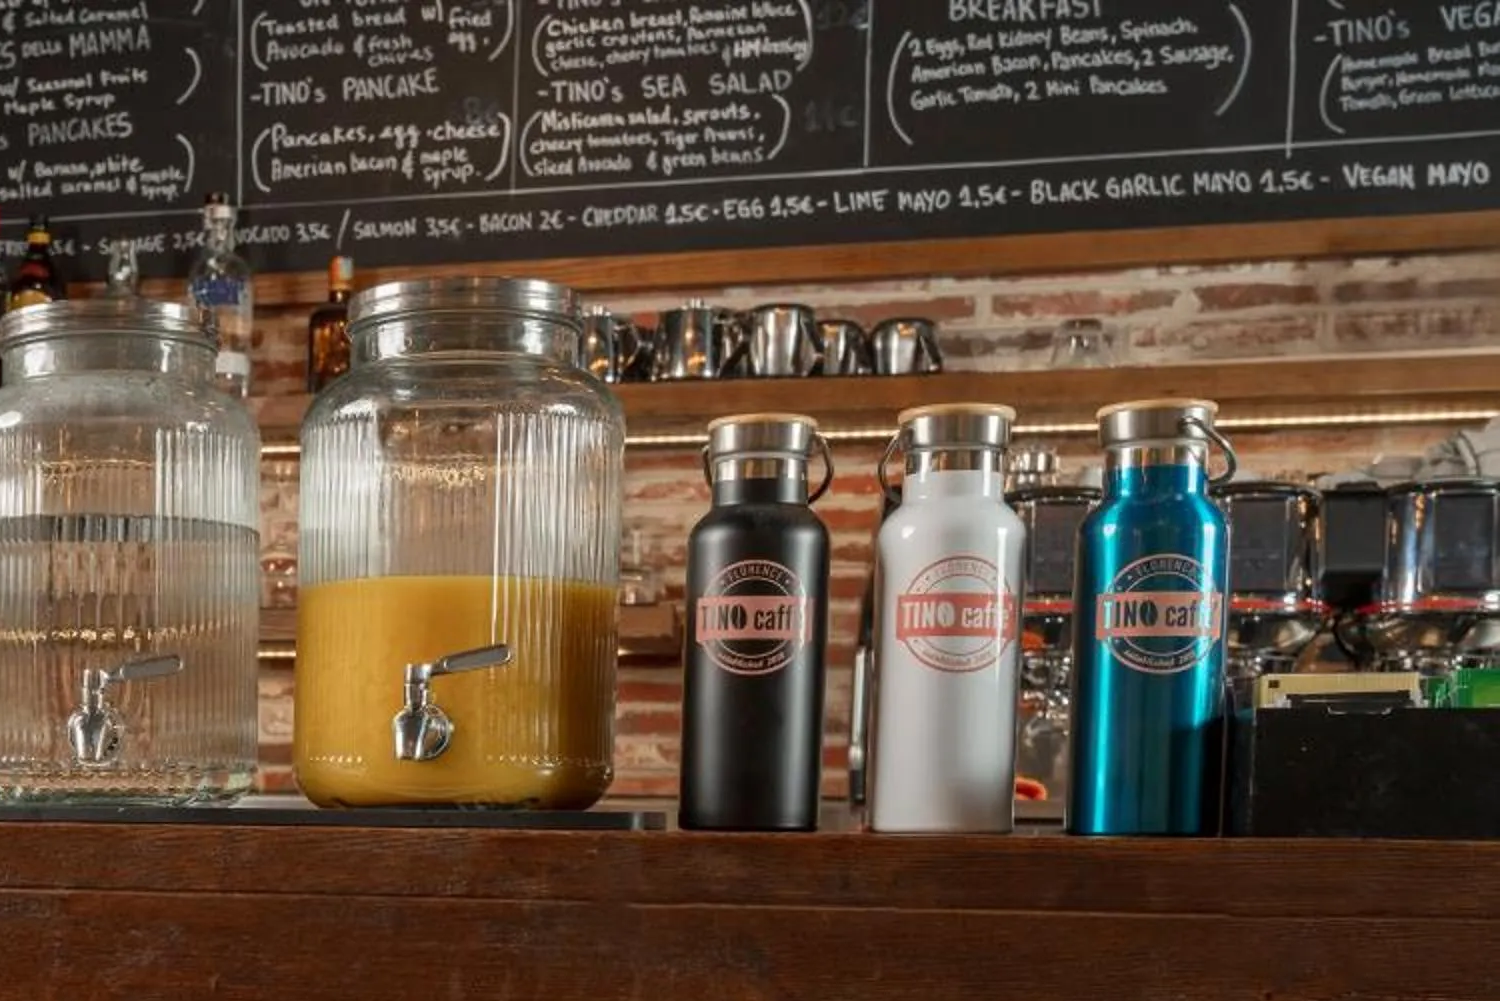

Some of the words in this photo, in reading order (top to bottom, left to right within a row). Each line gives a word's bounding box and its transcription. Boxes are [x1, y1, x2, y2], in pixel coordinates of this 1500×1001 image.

[352, 8, 407, 27] bread
[547, 18, 625, 37] Chicken
[1327, 9, 1411, 46] TINO's
[68, 24, 151, 58] MAMMA
[259, 77, 327, 106] TINO's
[342, 67, 441, 103] PANCAKE
[550, 76, 624, 103] TINO's
[640, 72, 688, 99] SEA
[709, 70, 793, 95] SALAD
[28, 112, 133, 146] PANCAKES
[353, 216, 417, 240] SALMON
[479, 210, 532, 232] BACON
[582, 204, 657, 228] CHEDDAR
[723, 199, 765, 221] EGG
[833, 188, 888, 213] LIME
[899, 188, 951, 214] MAYO
[1030, 178, 1098, 204] BLACK
[1105, 173, 1185, 199] GARLIC
[1193, 171, 1251, 196] MAYO
[1342, 161, 1415, 189] VEGAN
[1427, 160, 1490, 186] MAYO
[901, 601, 954, 630] TINO
